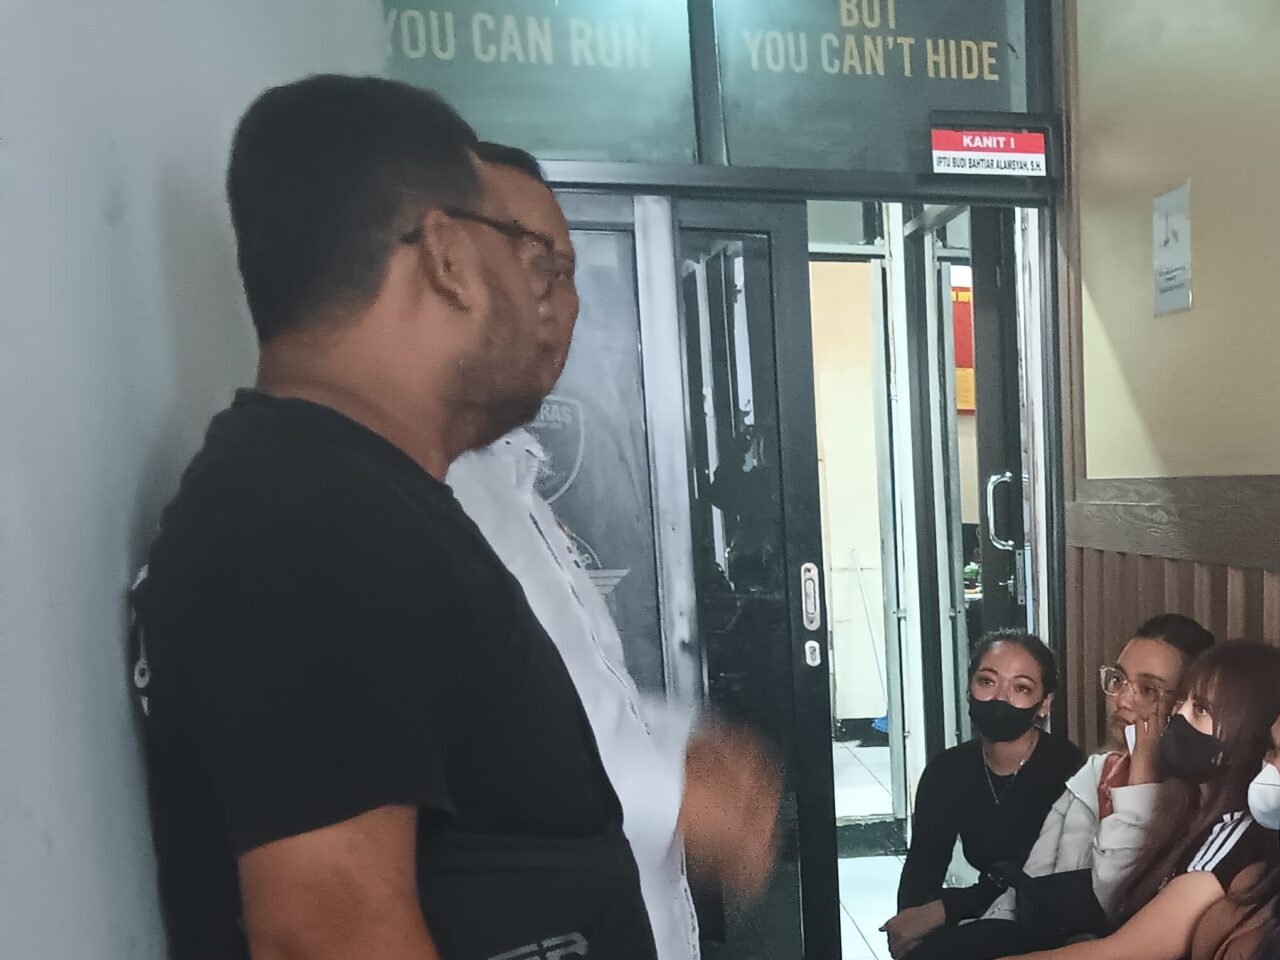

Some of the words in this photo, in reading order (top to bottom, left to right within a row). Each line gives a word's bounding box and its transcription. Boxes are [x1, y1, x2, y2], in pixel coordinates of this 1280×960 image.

[472, 12, 554, 65] CAN
[569, 18, 651, 69] RUN
[744, 30, 809, 73] YOU
[821, 33, 915, 77] CAN'T
[926, 38, 999, 81] HIDE
[962, 135, 1006, 148] KANIT
[952, 157, 966, 168] BUDI
